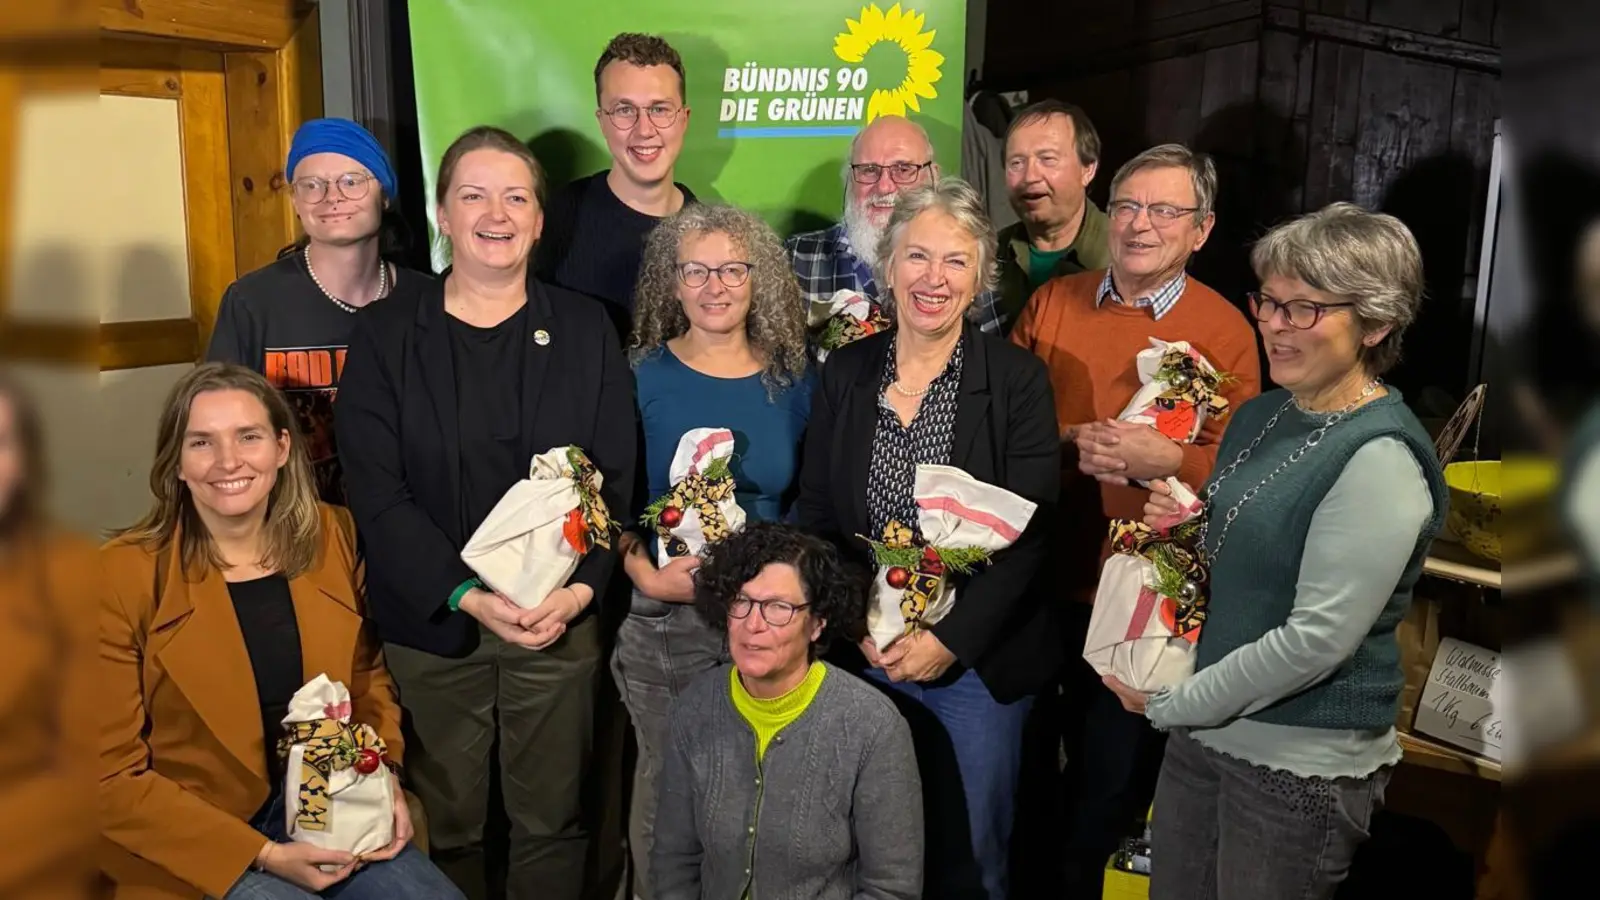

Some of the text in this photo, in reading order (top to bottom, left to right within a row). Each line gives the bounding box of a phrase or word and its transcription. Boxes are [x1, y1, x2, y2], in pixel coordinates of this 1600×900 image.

[723, 61, 868, 93] BÜNDNIS 90
[720, 92, 864, 122] DIE GRÜNEN
